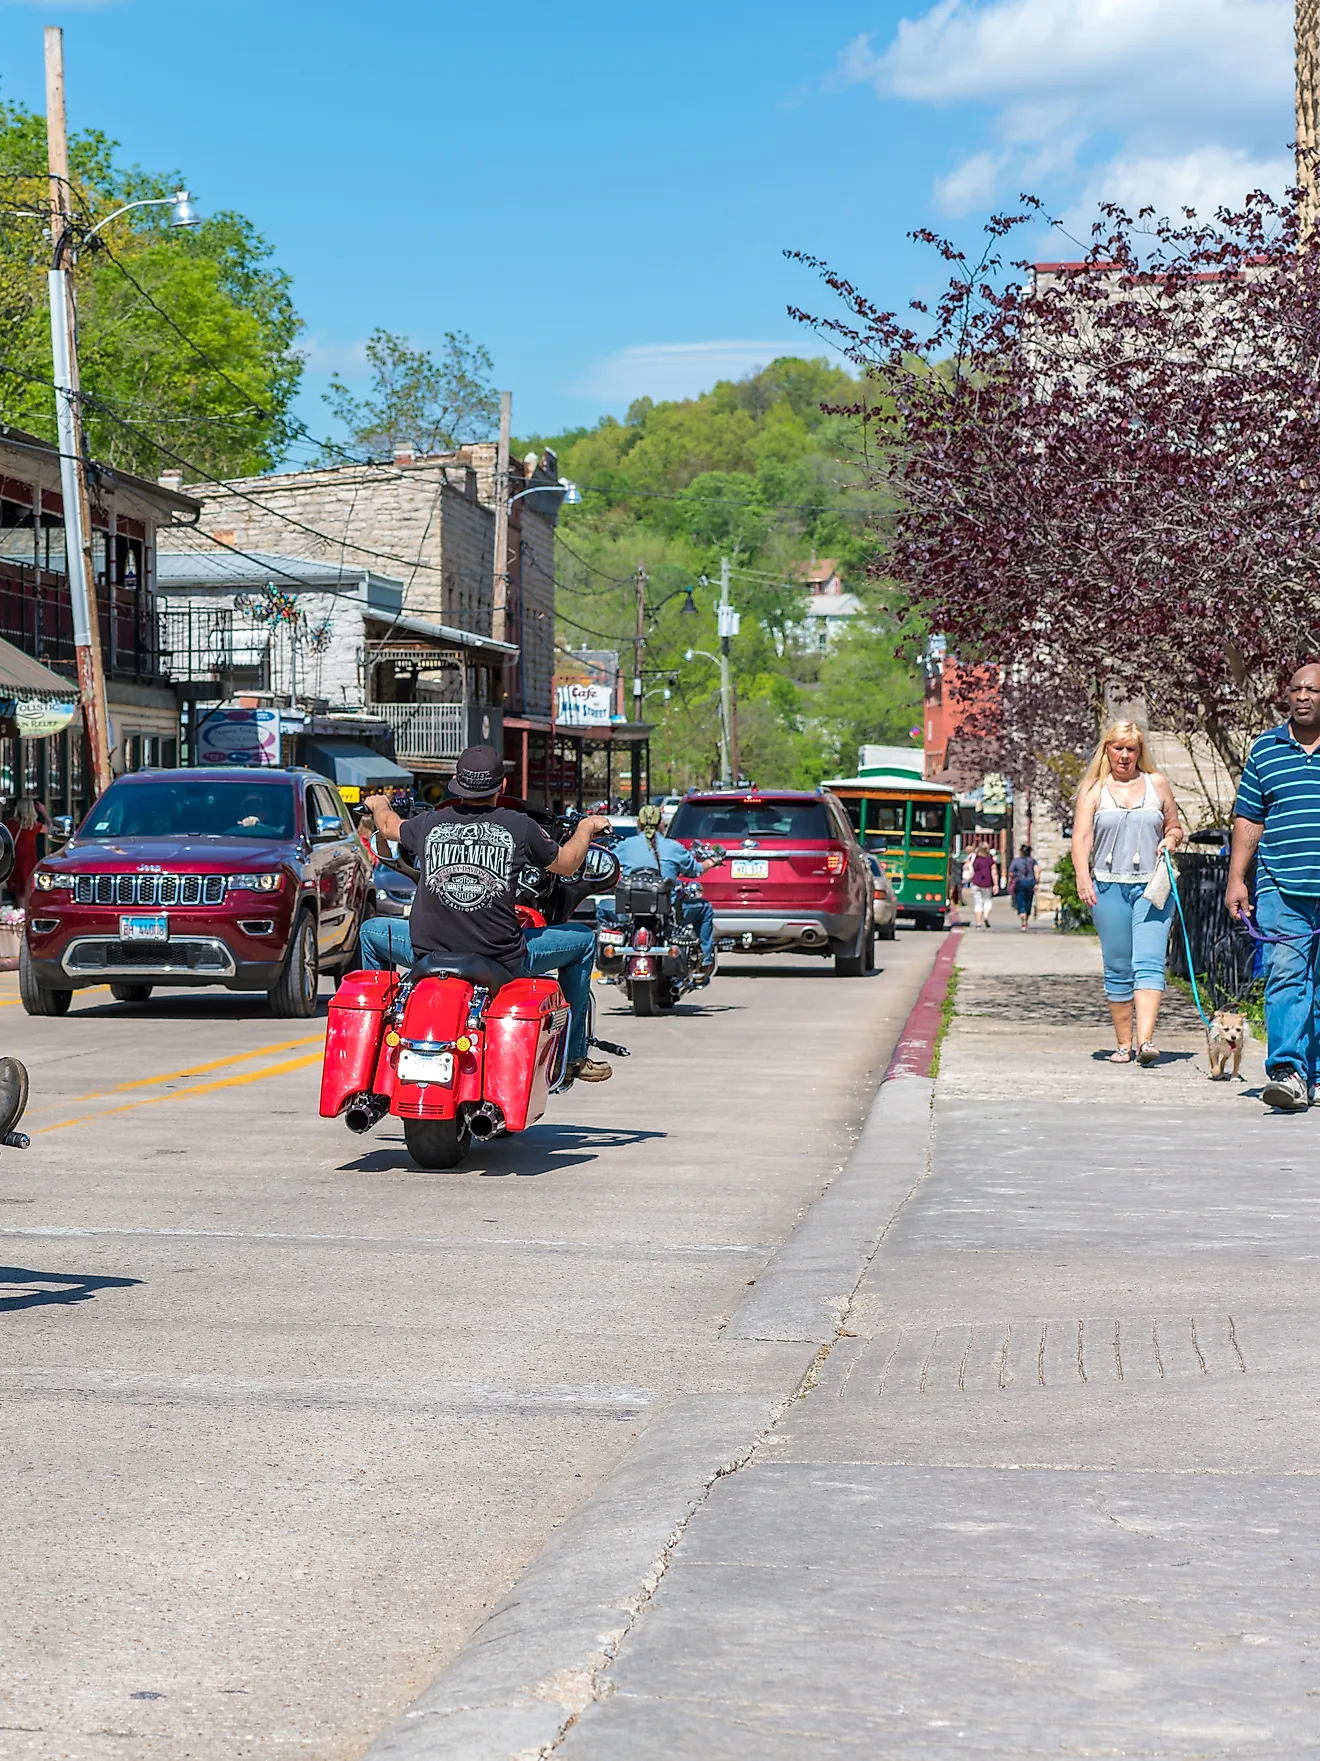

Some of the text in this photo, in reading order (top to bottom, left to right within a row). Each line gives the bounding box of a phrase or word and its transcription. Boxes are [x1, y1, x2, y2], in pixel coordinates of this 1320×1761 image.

[18, 702, 60, 712] OLISTIC
[582, 704, 608, 718] STREET
[430, 842, 506, 879] SANTA MARIA
[136, 863, 162, 873] Jeep
